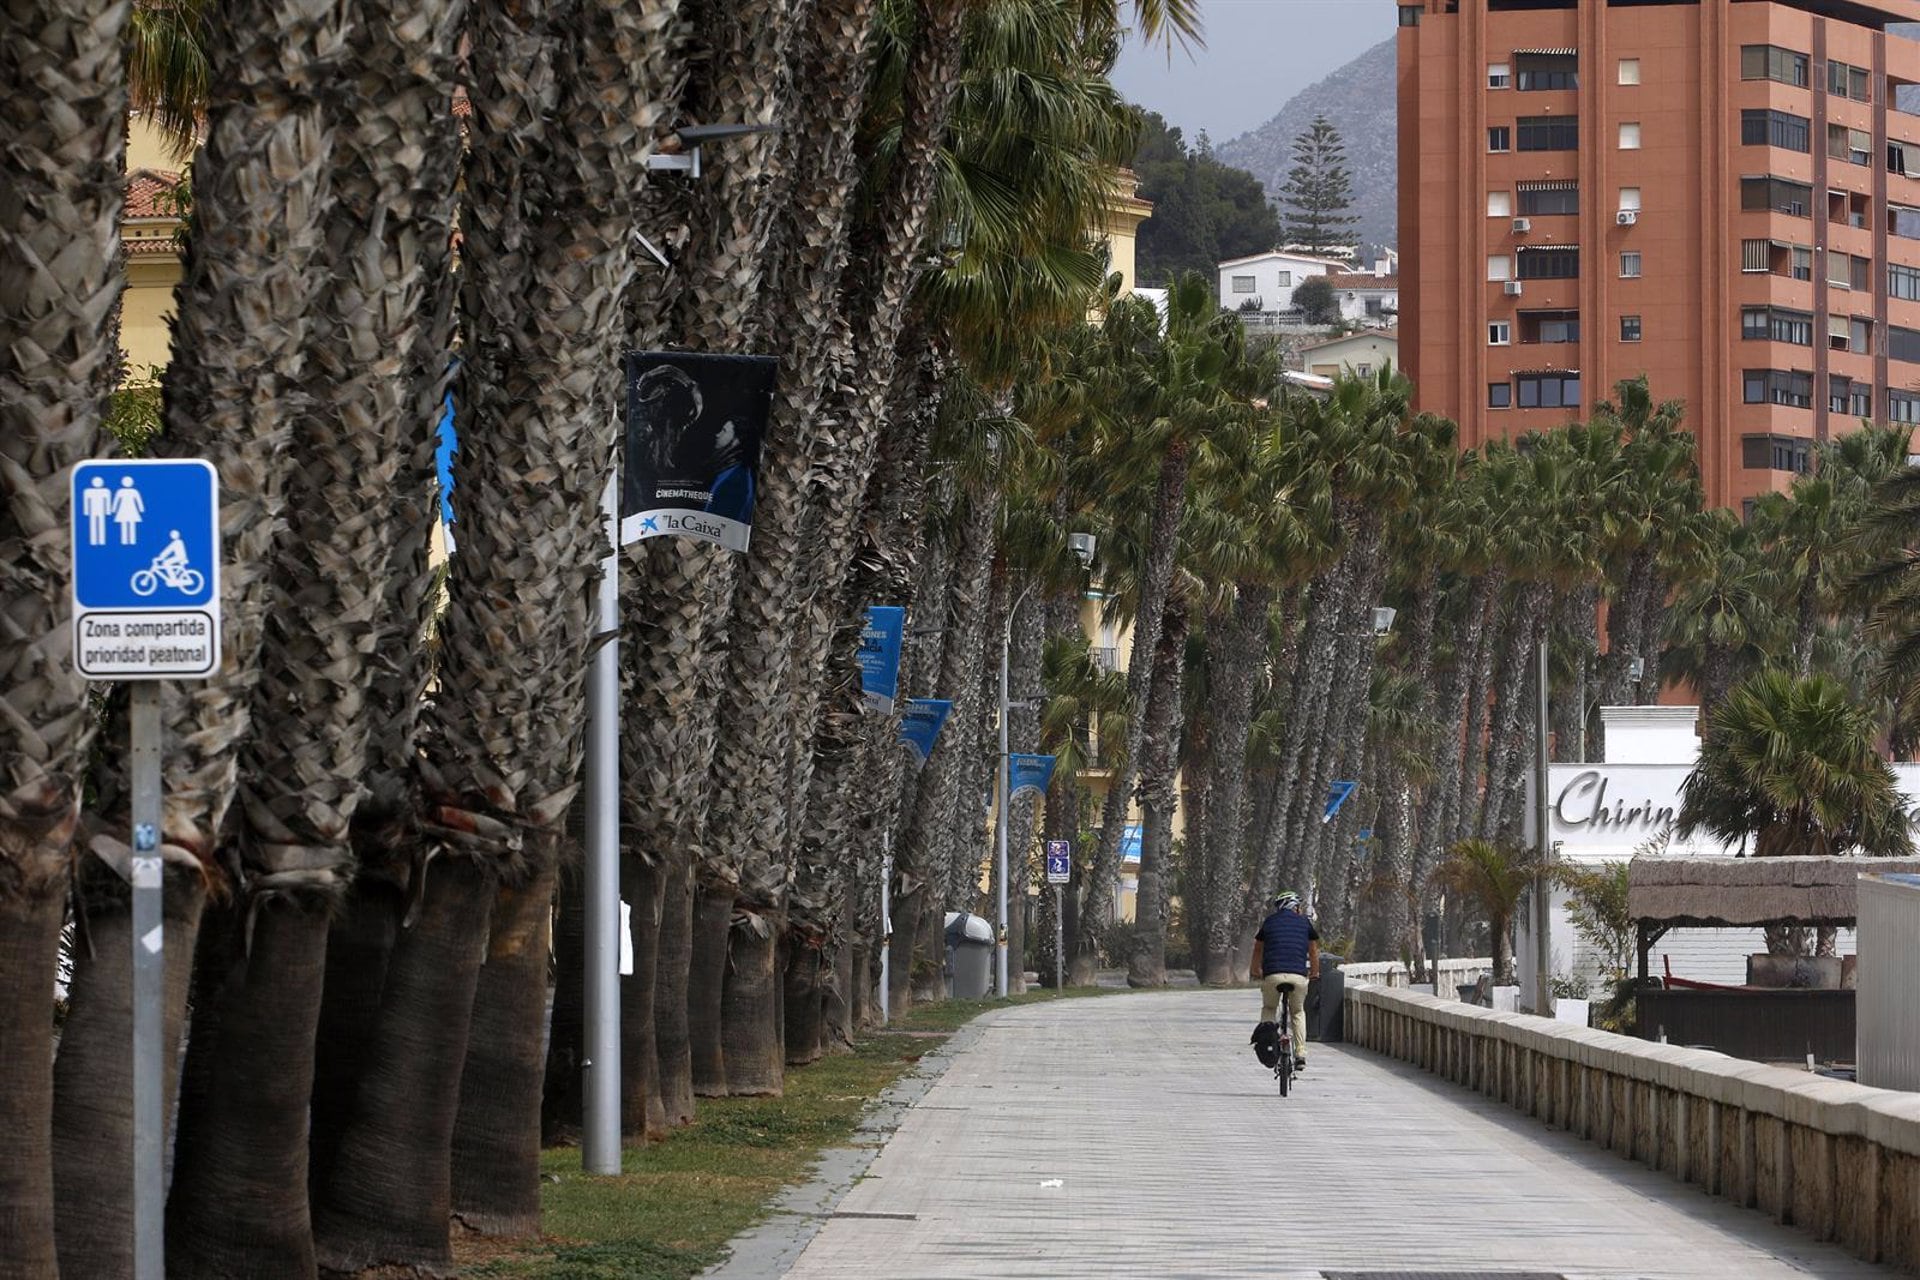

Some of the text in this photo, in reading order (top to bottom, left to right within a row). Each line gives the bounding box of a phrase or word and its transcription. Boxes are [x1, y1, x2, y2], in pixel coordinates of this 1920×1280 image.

[86, 619, 205, 640] Zona compartida
[86, 646, 206, 666] prioridad peatonal
